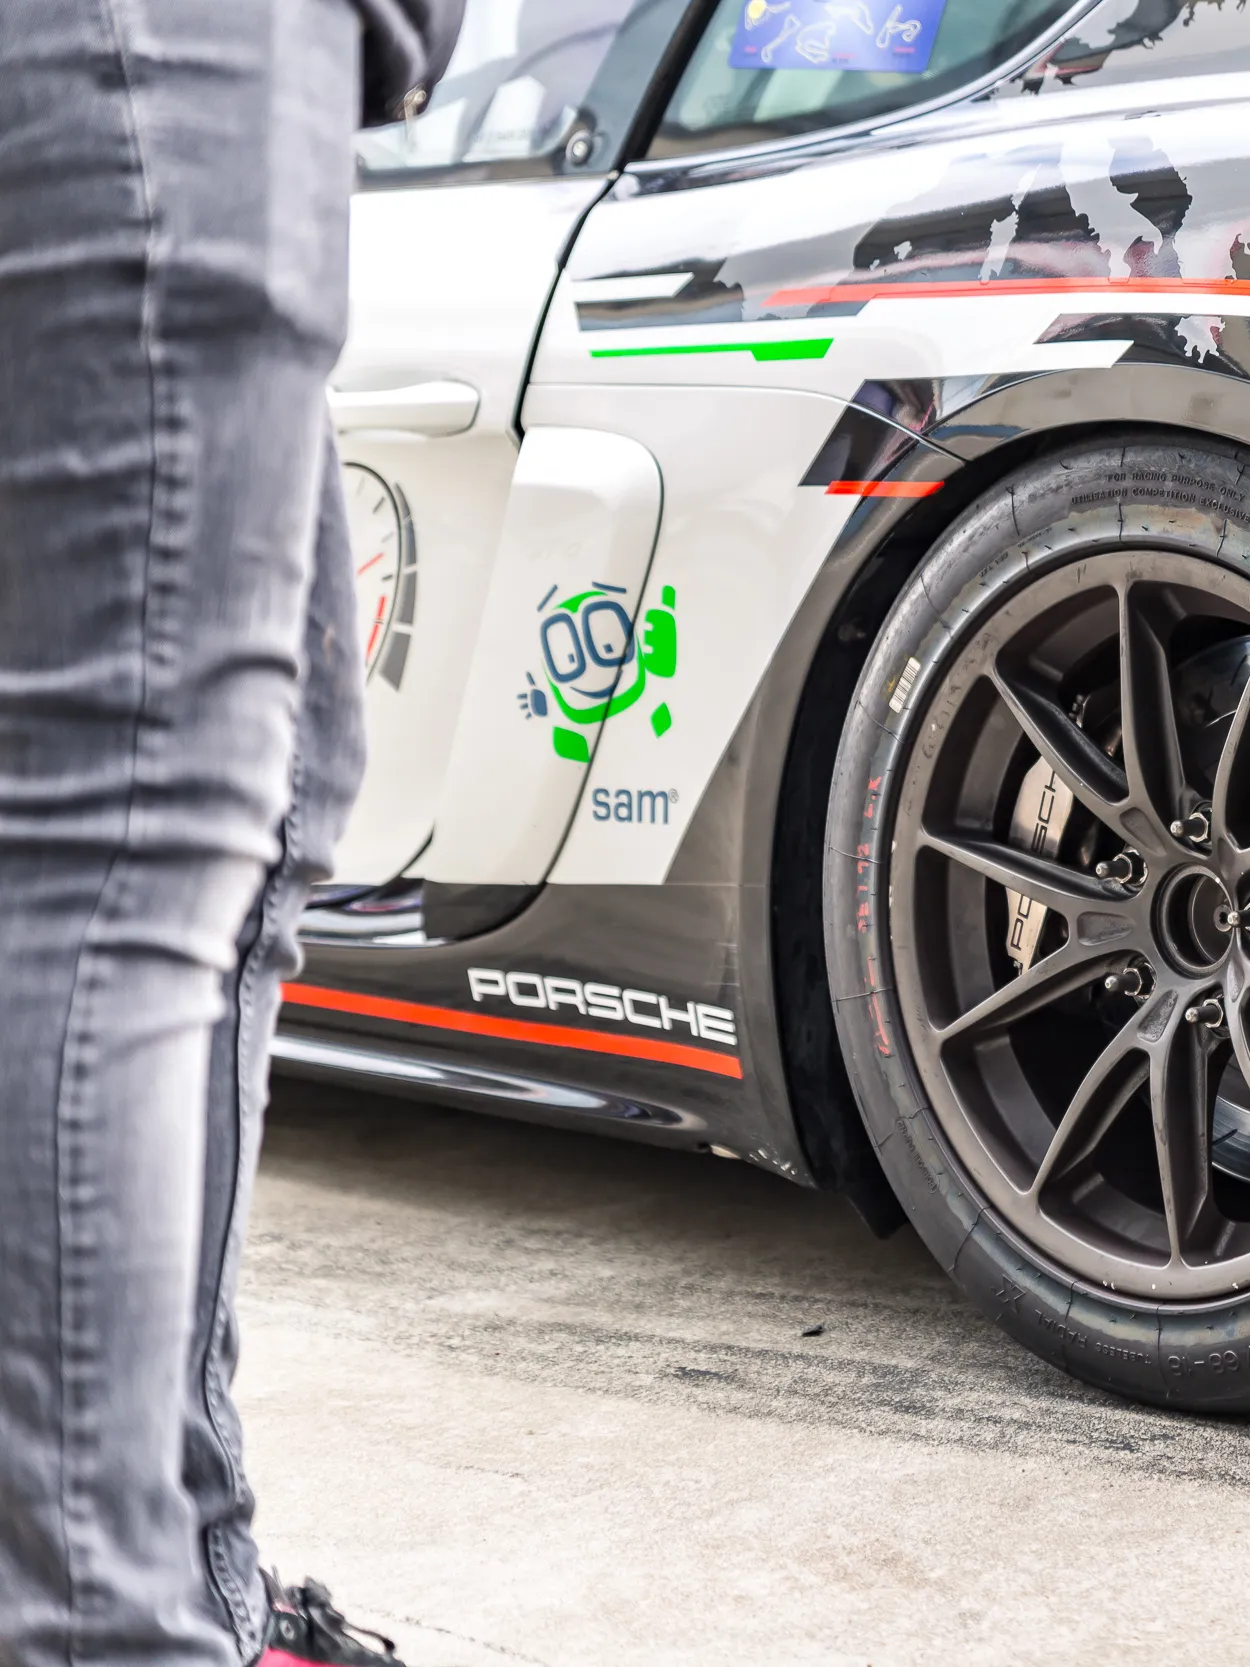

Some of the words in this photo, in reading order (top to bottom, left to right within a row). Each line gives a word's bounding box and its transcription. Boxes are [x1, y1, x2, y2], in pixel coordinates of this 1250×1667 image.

[1107, 472, 1127, 483] FOR
[1132, 472, 1167, 482] RACING
[1171, 475, 1215, 492] PURPOSE
[1220, 486, 1246, 502] ONLY
[1132, 487, 1196, 503] COMPETITION
[467, 967, 737, 1046] PORSCHE
[1035, 1308, 1088, 1349] RADIAL
[1095, 1341, 1151, 1364] TUBELESS
